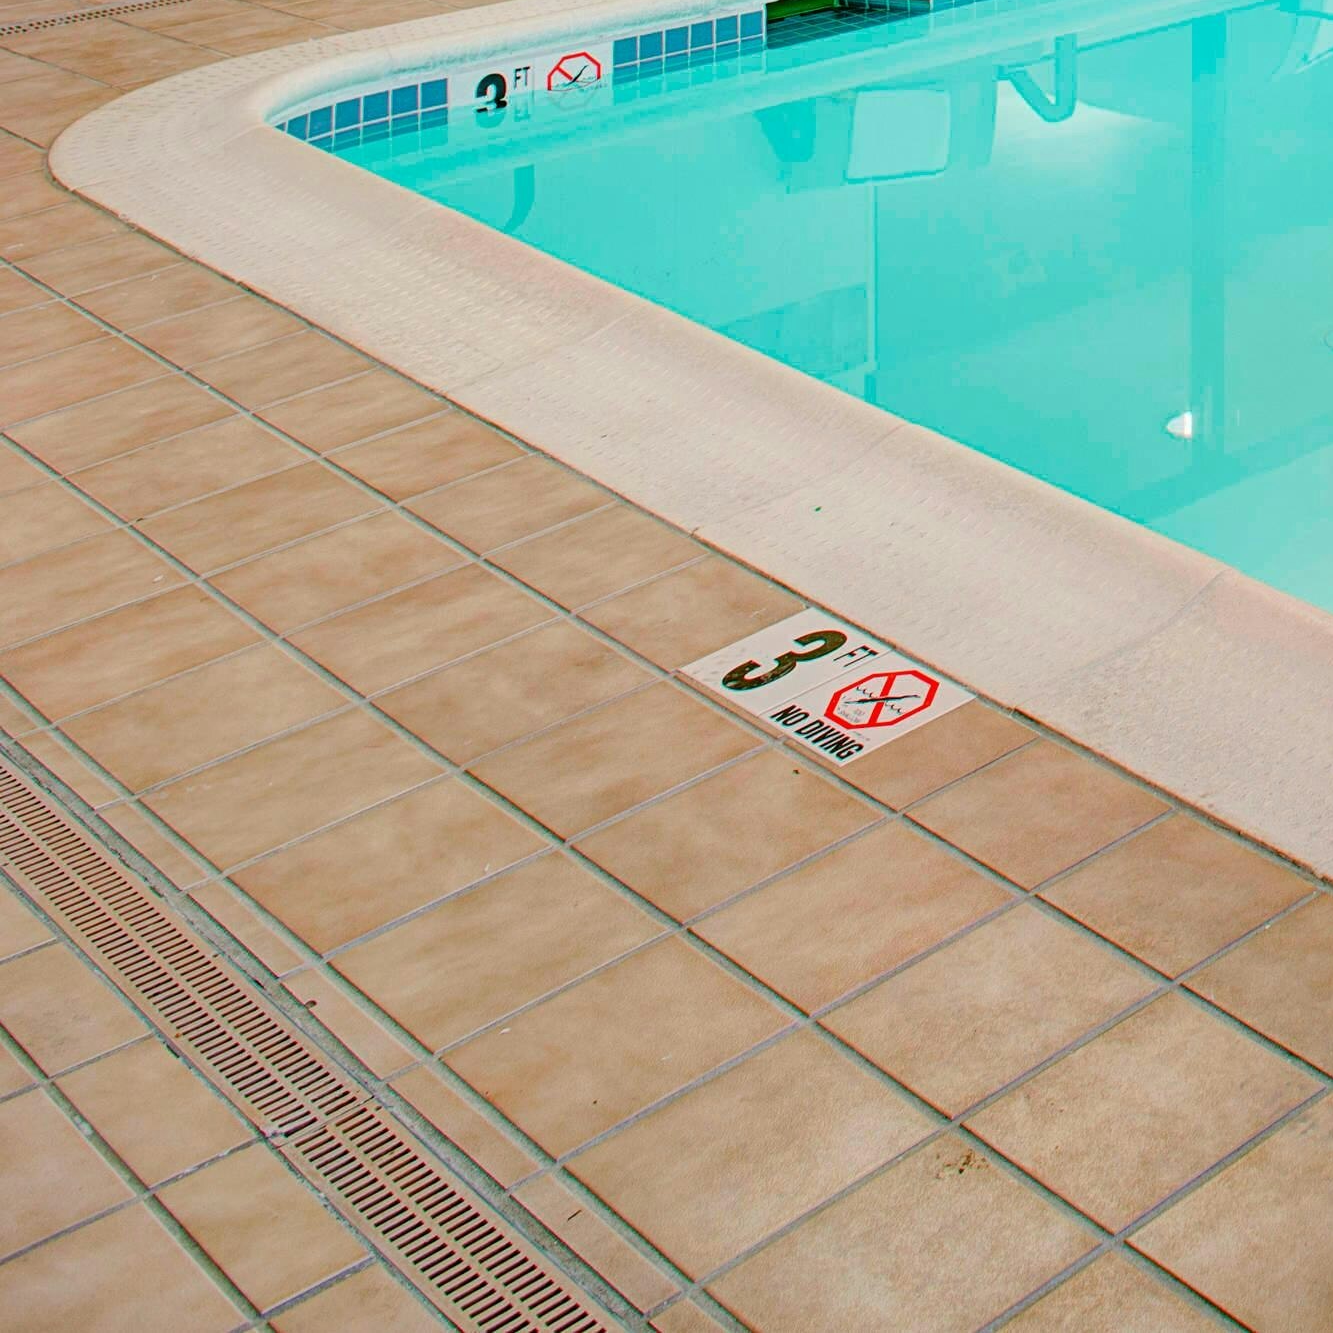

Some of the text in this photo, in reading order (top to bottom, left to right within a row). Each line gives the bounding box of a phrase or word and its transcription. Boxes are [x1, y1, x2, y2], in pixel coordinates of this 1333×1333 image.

[475, 66, 531, 113] 3 FT
[721, 629, 879, 691] 3 FT
[770, 704, 864, 761] NO DIVING
